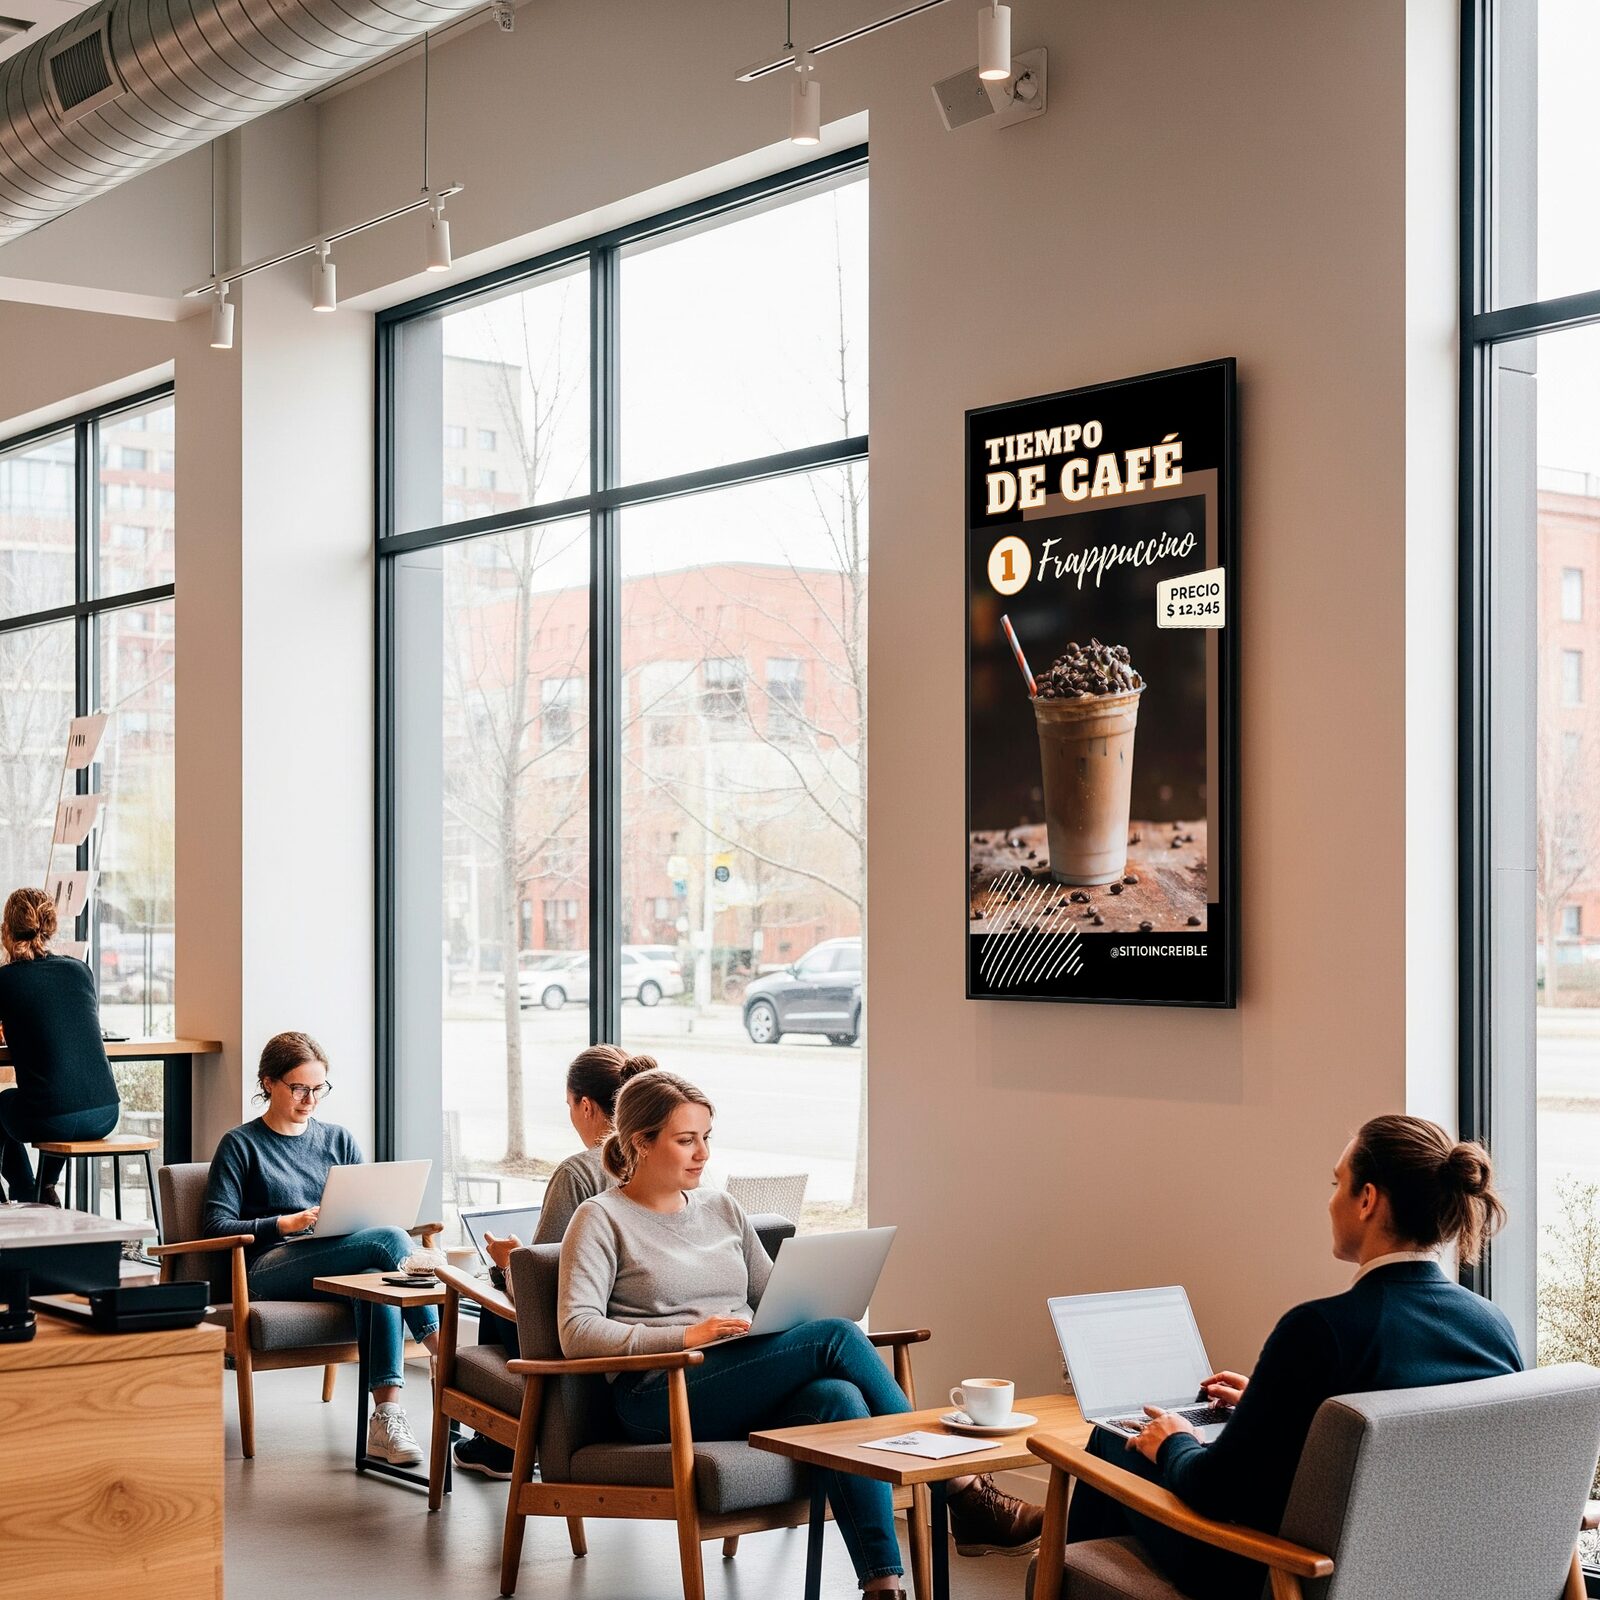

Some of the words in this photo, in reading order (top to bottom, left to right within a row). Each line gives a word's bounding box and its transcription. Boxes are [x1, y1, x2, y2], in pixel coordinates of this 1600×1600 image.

[985, 420, 1103, 465] TIEMPO
[985, 464, 1047, 515] DE
[1060, 432, 1183, 502] CAFÉ
[1000, 549, 1016, 582] 1
[1036, 531, 1198, 590] Frappuccino
[1170, 583, 1220, 601] PRECIO
[1110, 945, 1208, 958] @SITIOINCREIBLE
